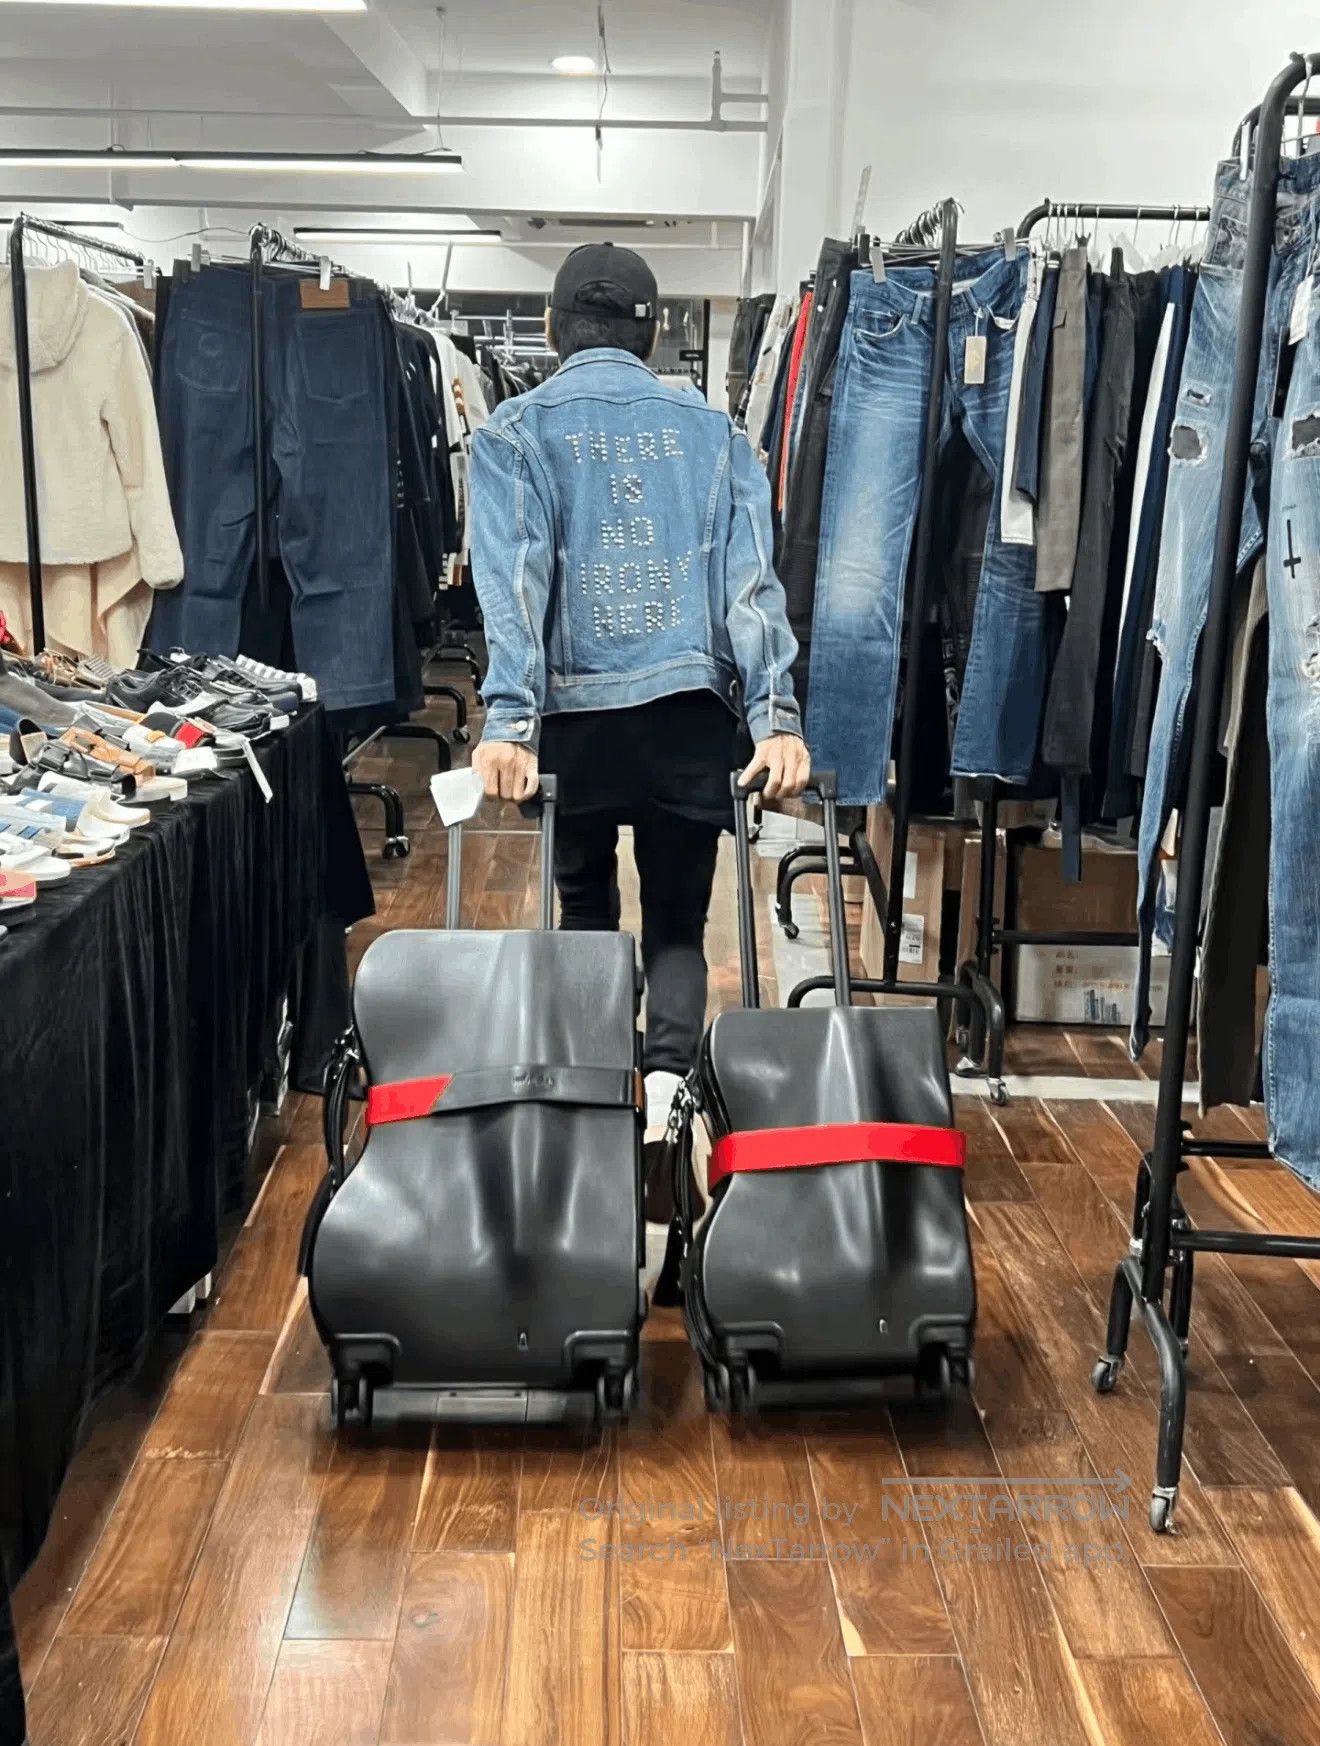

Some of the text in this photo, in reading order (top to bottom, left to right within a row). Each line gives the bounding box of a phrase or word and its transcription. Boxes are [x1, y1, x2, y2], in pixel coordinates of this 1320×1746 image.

[564, 428, 684, 464] THERE
[610, 473, 644, 505] IS
[601, 516, 655, 550] NO
[580, 550, 692, 595] IRONY
